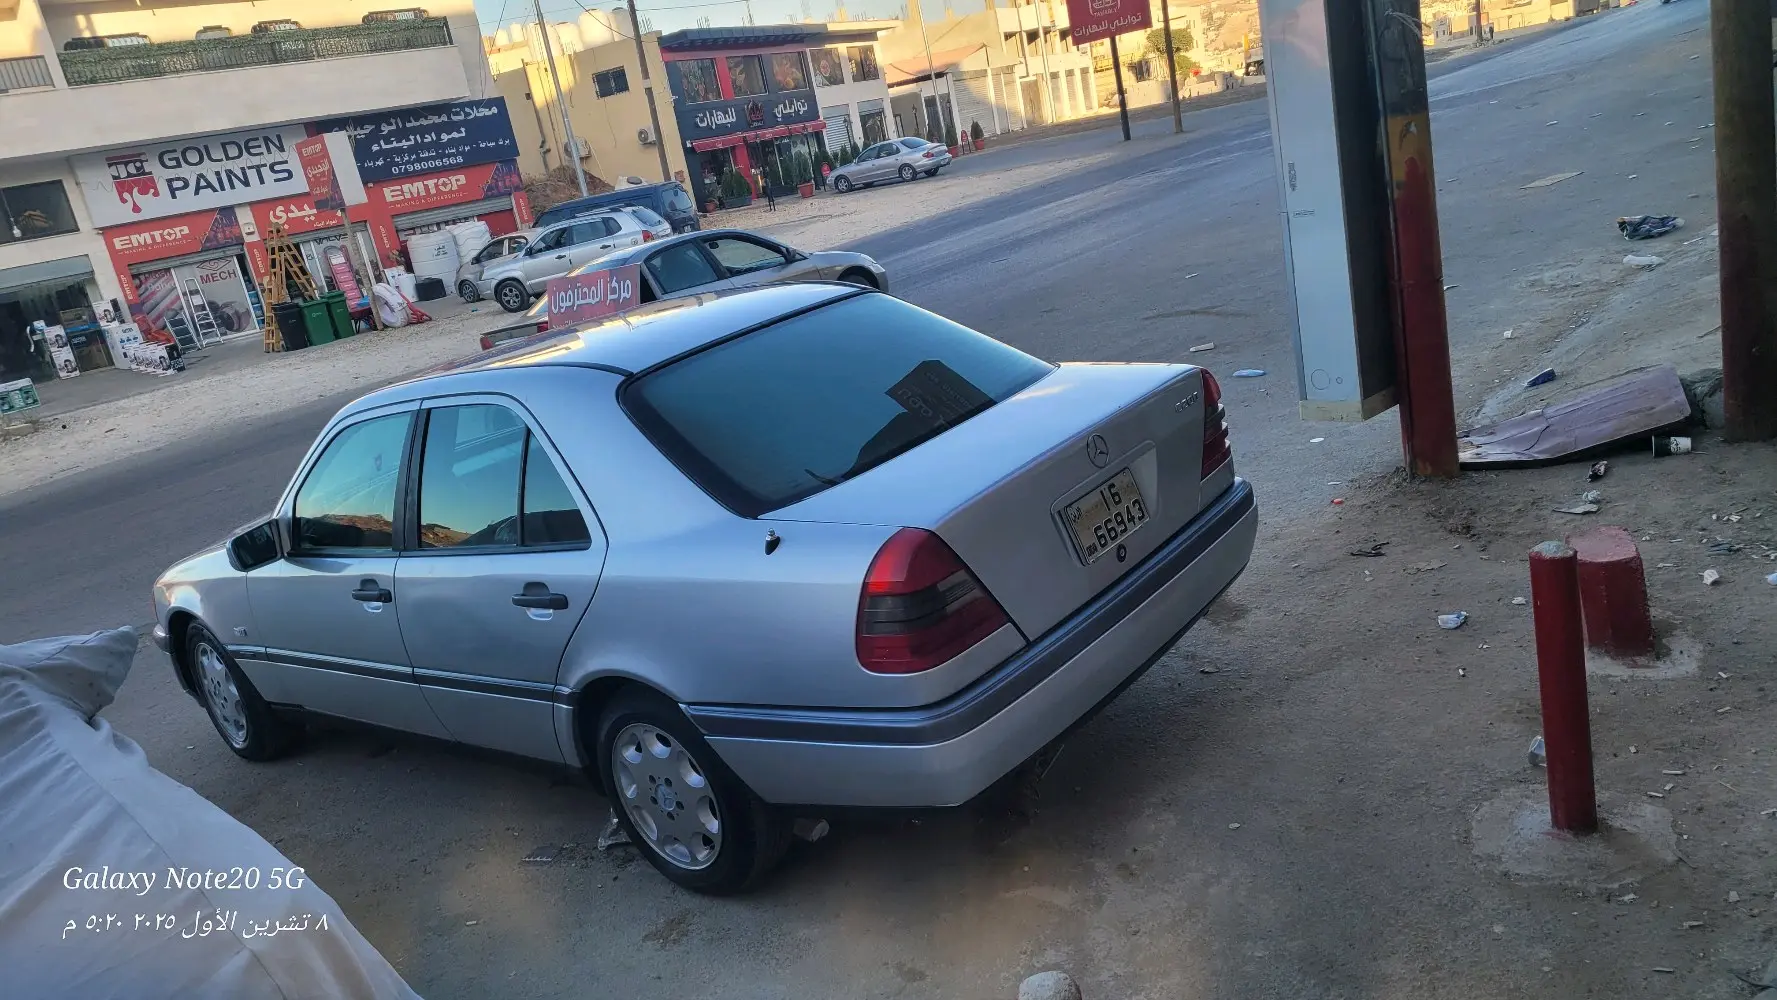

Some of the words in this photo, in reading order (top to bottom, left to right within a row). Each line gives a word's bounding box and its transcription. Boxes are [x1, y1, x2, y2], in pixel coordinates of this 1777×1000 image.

[1074, 20, 1108, 37] للبهارات
[1110, 13, 1142, 32] توابلي
[405, 113, 448, 128] محمد
[450, 104, 498, 121] محلات
[695, 107, 737, 129] للبهارات
[772, 98, 808, 121] توابلي
[371, 133, 421, 152] البناء
[424, 127, 466, 143] لمواد
[158, 134, 286, 170] GOLDEN
[391, 155, 464, 174] 0798006568
[166, 160, 294, 199] PAINTS
[383, 174, 466, 202] EMTOP
[113, 226, 190, 249] EMTOP
[200, 269, 238, 284] MECH
[551, 278, 604, 314] المحترفون
[606, 275, 632, 306] مركز
[1100, 482, 1122, 511] 16
[1093, 498, 1145, 548] 66943
